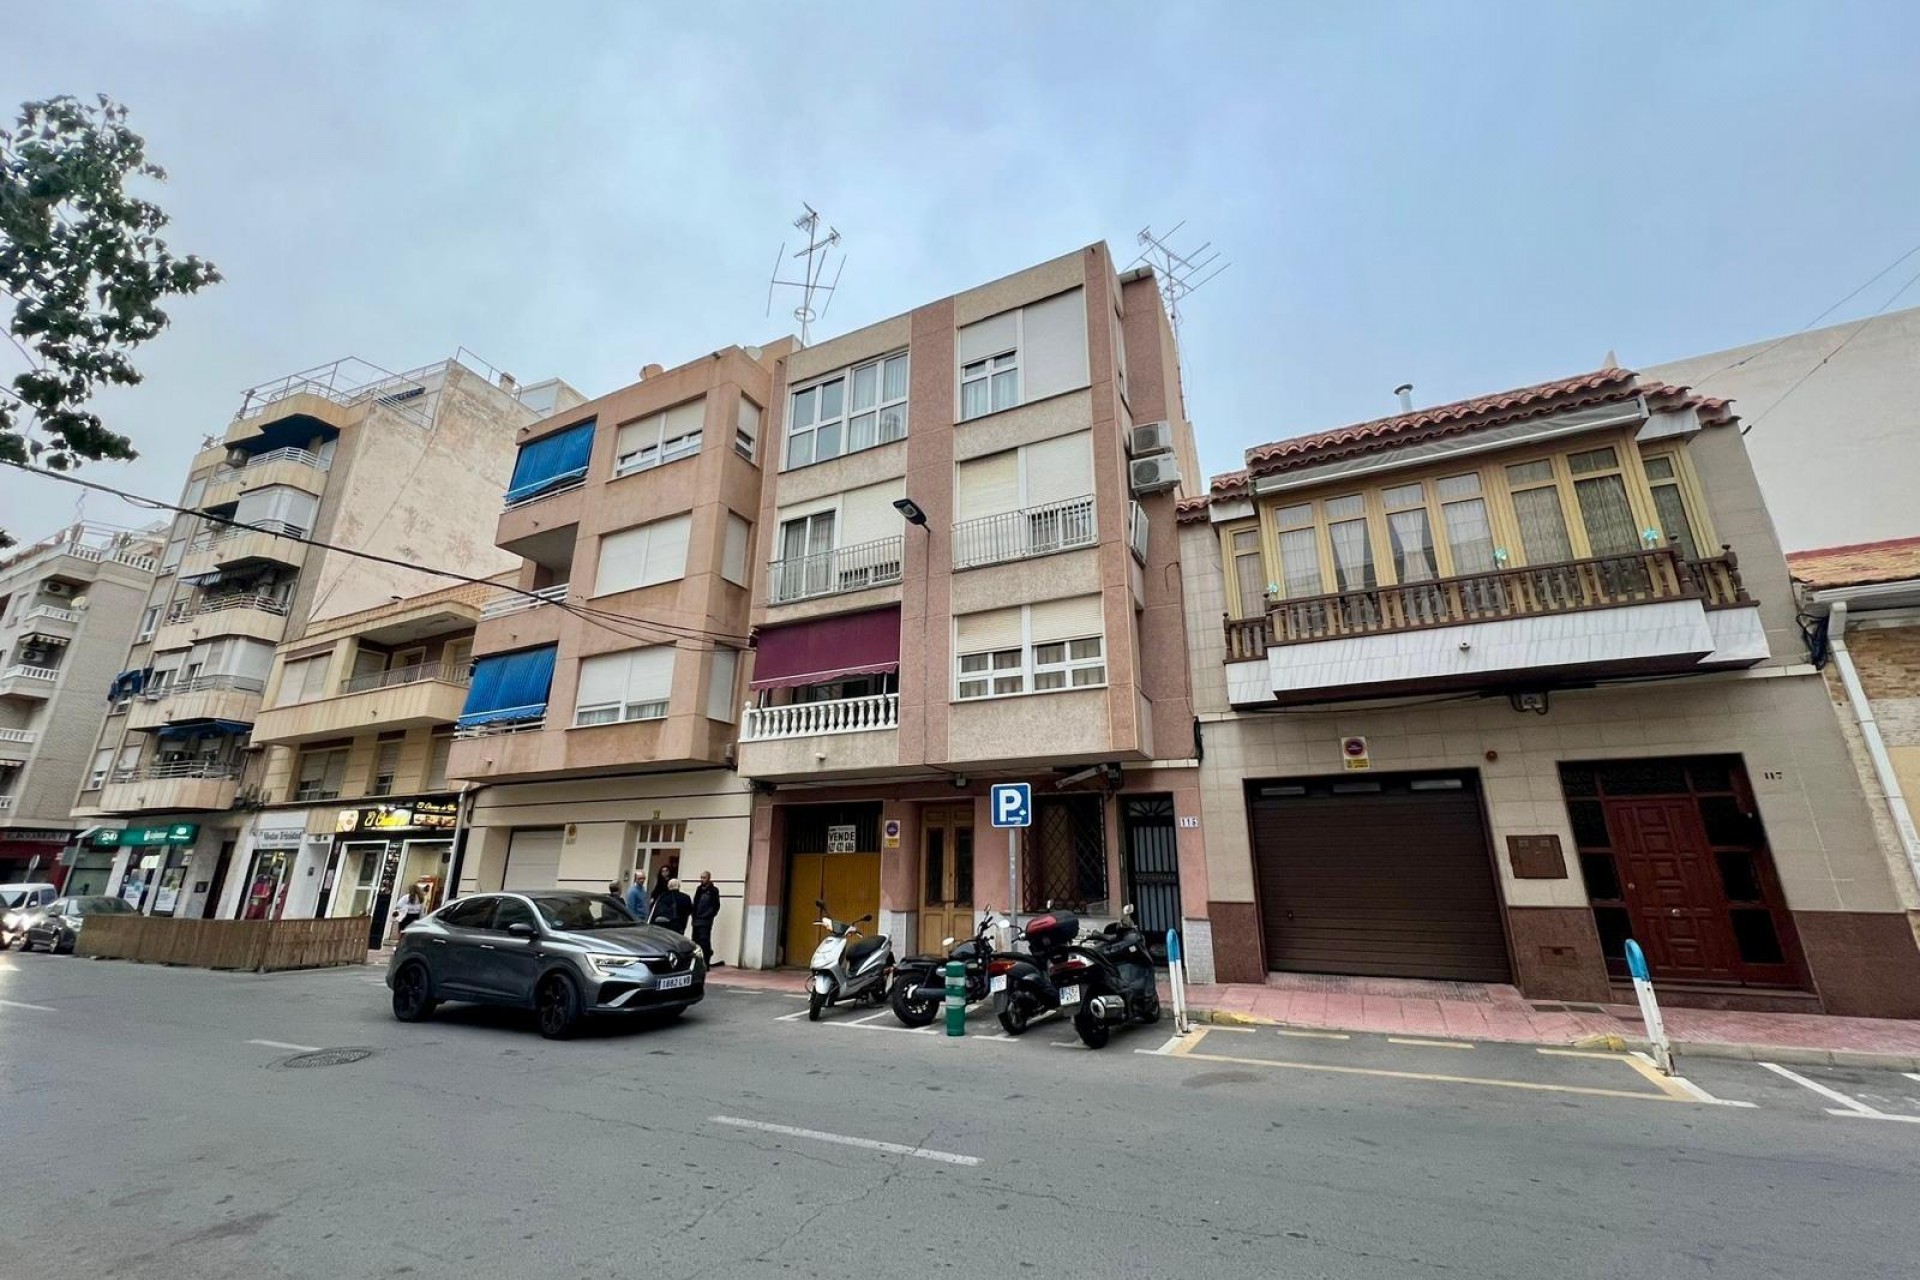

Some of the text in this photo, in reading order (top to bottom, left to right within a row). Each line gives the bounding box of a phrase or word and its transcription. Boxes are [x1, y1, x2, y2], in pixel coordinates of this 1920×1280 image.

[1764, 772, 1782, 780] 117
[999, 789, 1022, 822] P
[828, 831, 855, 841] VENDE
